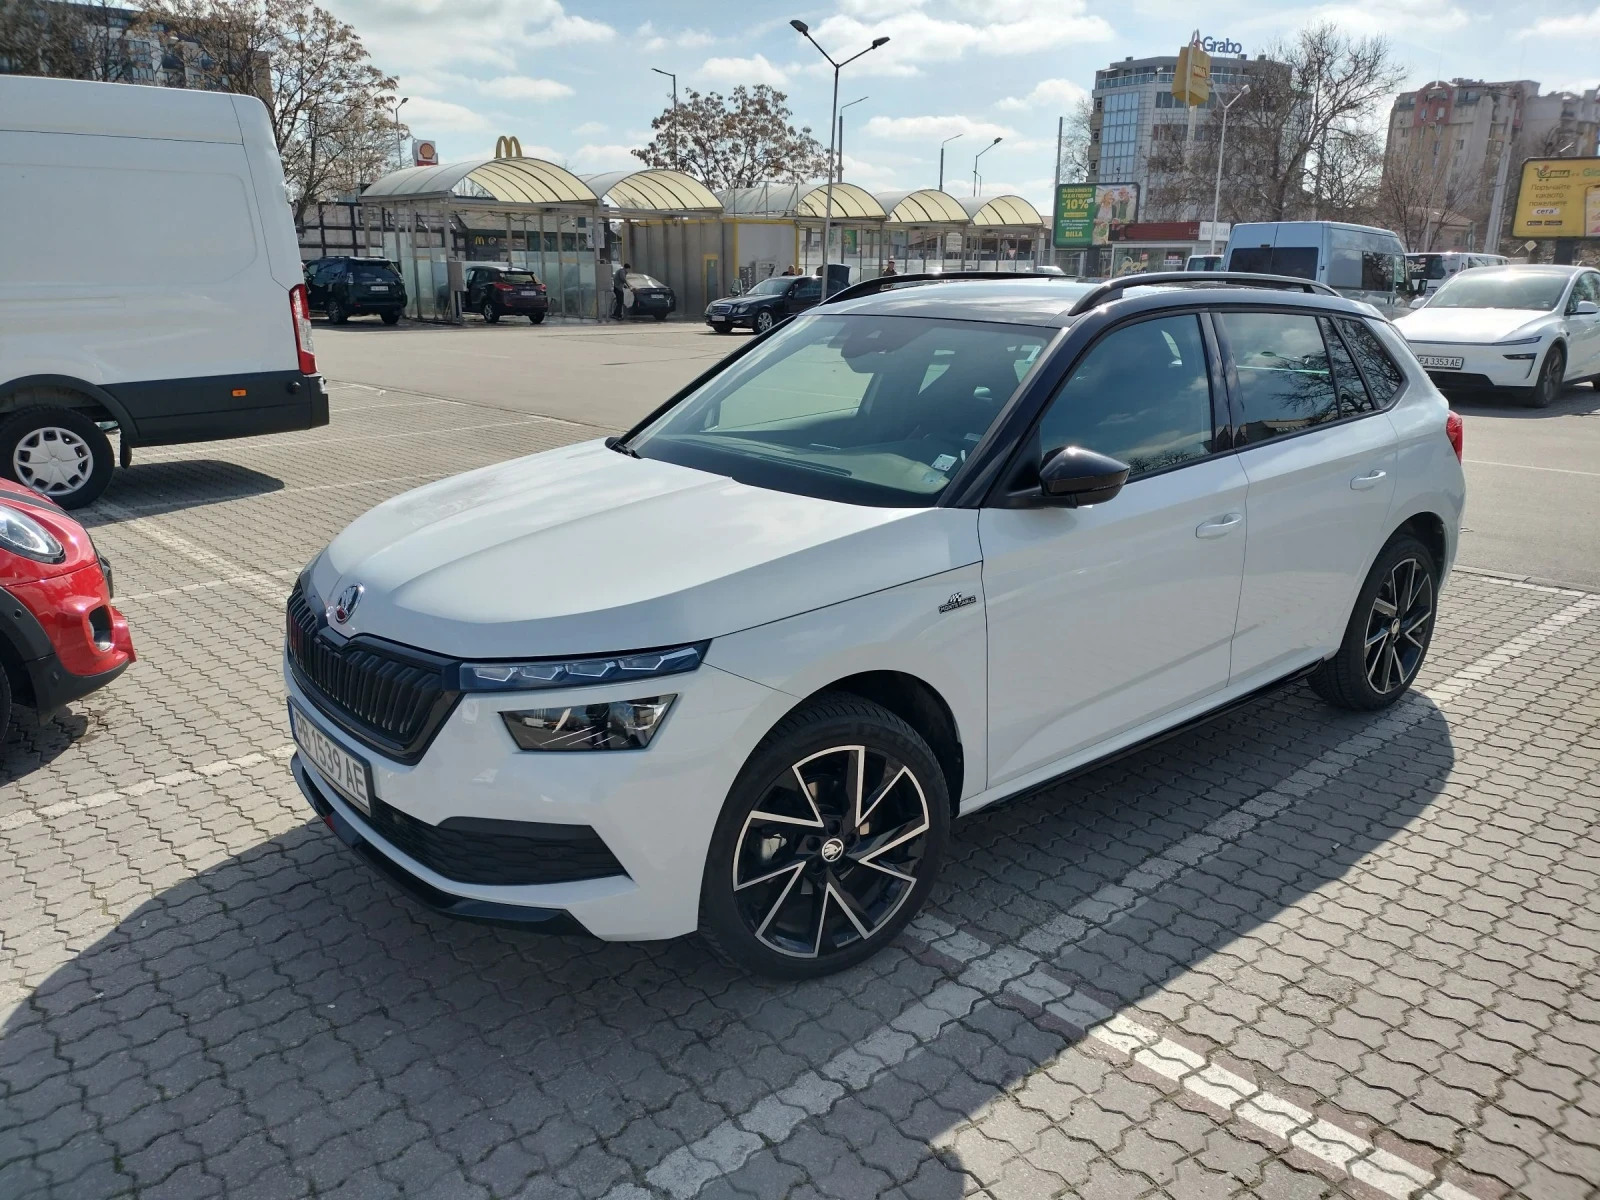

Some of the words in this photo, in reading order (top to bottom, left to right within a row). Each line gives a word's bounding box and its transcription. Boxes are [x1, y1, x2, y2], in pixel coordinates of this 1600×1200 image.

[1202, 36, 1242, 54] Grabo
[1061, 198, 1089, 209] -10%
[1419, 357, 1428, 365] EA
[1430, 358, 1449, 366] 3353
[1450, 359, 1461, 367] AE
[312, 729, 342, 781] 1539
[346, 757, 367, 801] AE
